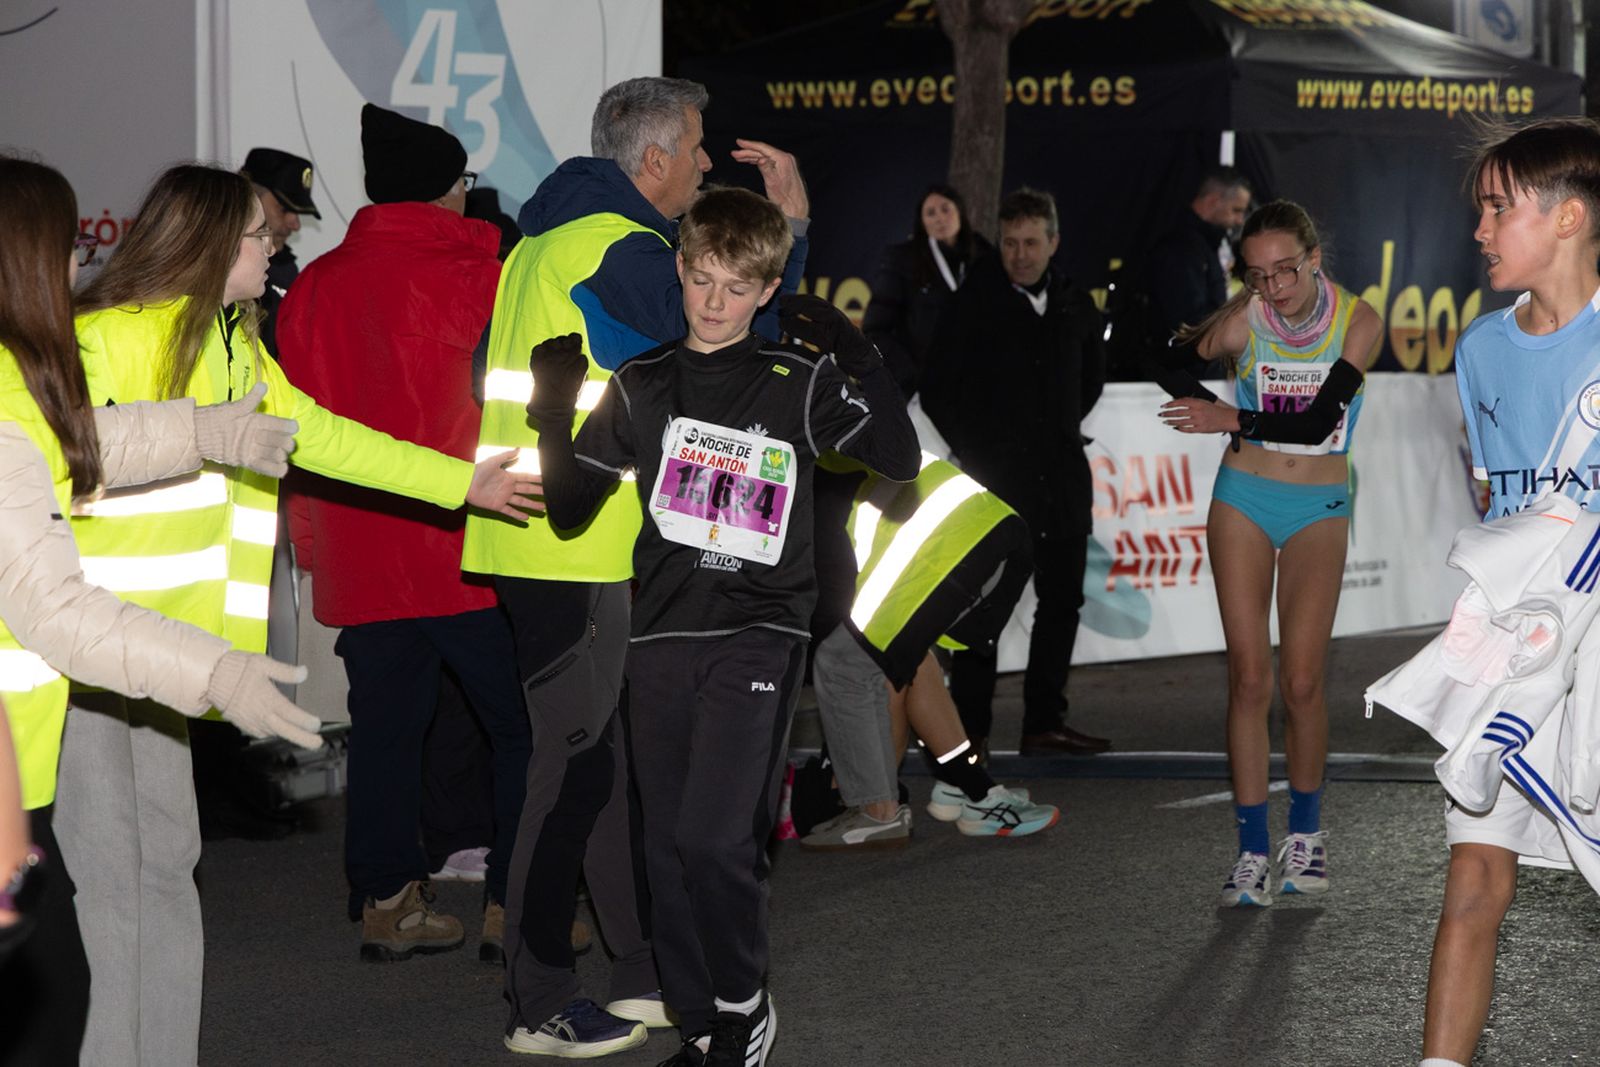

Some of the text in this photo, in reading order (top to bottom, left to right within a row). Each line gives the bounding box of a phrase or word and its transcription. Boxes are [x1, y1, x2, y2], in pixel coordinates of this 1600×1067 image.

[391, 8, 507, 174] 43
[1296, 75, 1535, 119] www.evedeport.es
[1267, 383, 1287, 393] SAN
[1279, 373, 1322, 383] NOCHE DE
[698, 436, 735, 455] NOCHE
[735, 445, 752, 459] DE
[679, 447, 707, 464] SAN
[707, 454, 748, 475] ANTÓN
[1091, 454, 1194, 519] SAN
[751, 681, 776, 691] FILA
